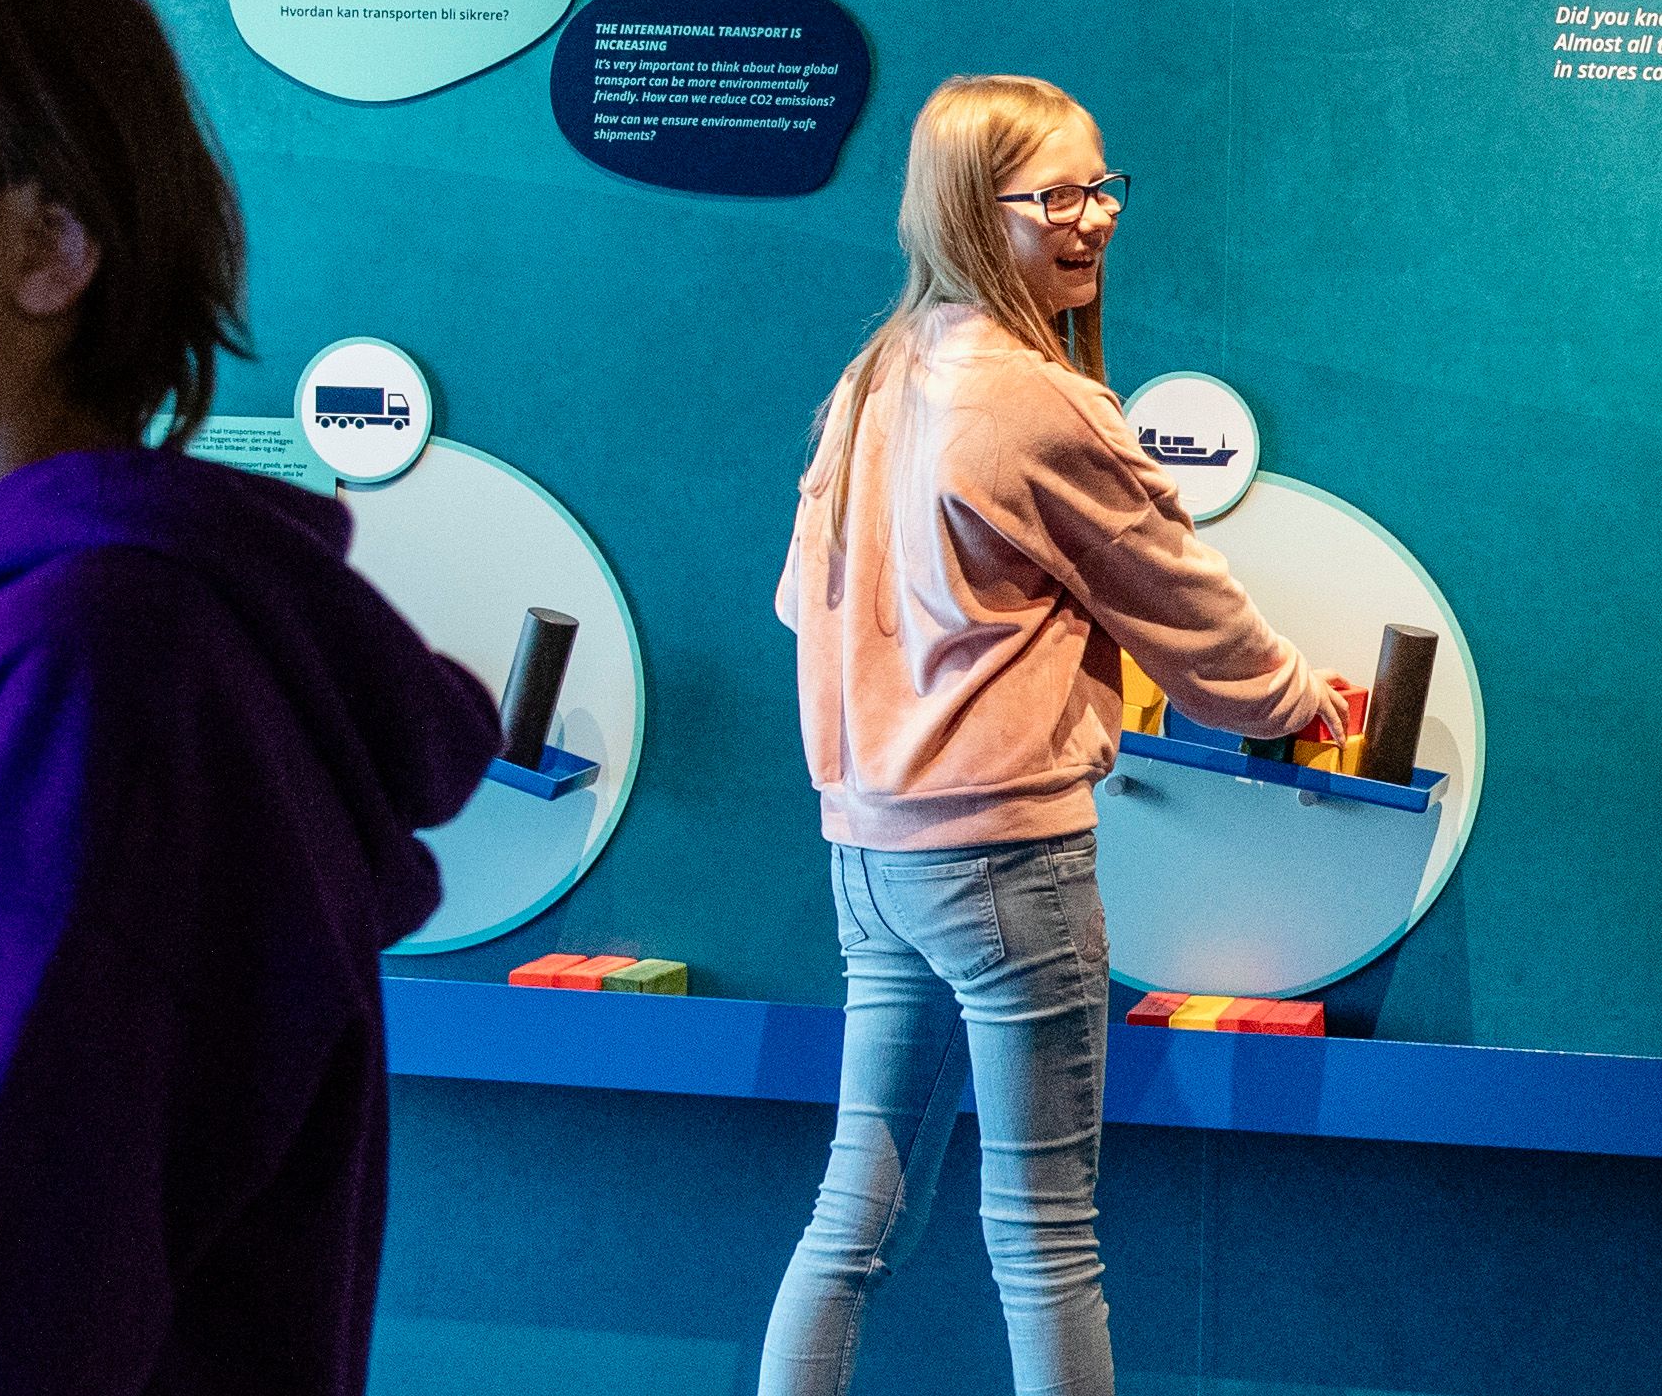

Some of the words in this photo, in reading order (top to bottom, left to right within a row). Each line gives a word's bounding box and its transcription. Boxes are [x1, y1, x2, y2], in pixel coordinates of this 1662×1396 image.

[280, 5, 332, 17] Hvordan
[336, 5, 359, 18] kan
[362, 7, 437, 21] transporten
[440, 7, 456, 20] bli
[459, 8, 509, 21] sikrere?
[1554, 5, 1591, 26] Did
[1590, 10, 1631, 31] you
[595, 22, 618, 34] THE
[619, 22, 715, 36] INTERNATIONAL
[718, 24, 789, 38] TRANSPORT
[790, 27, 802, 39] IS
[595, 38, 667, 51] INCREASING
[1552, 32, 1624, 54] Almost
[1626, 34, 1654, 55] all
[613, 60, 637, 73] very
[638, 58, 695, 73] important
[697, 60, 709, 72] to
[711, 60, 740, 72] think
[742, 61, 776, 73] about
[777, 61, 802, 74] how
[802, 62, 839, 77] global
[1552, 59, 1574, 79] in
[1576, 62, 1639, 82] stores
[594, 74, 647, 88] transport
[648, 76, 669, 87] can
[671, 74, 686, 88] be
[687, 78, 717, 88] more
[719, 77, 810, 93] environmentally
[592, 89, 639, 104] friendly.
[641, 91, 667, 103] How
[668, 93, 689, 103] can
[691, 94, 707, 104] we
[709, 91, 747, 105] reduce
[749, 92, 773, 105] CO2
[774, 93, 836, 107] emissions?
[594, 112, 620, 124] How
[620, 114, 641, 124] can
[643, 115, 660, 125] we
[661, 115, 699, 127] ensure
[701, 114, 792, 132] environmentally
[793, 116, 817, 132] safe
[594, 127, 657, 143] shipments?
